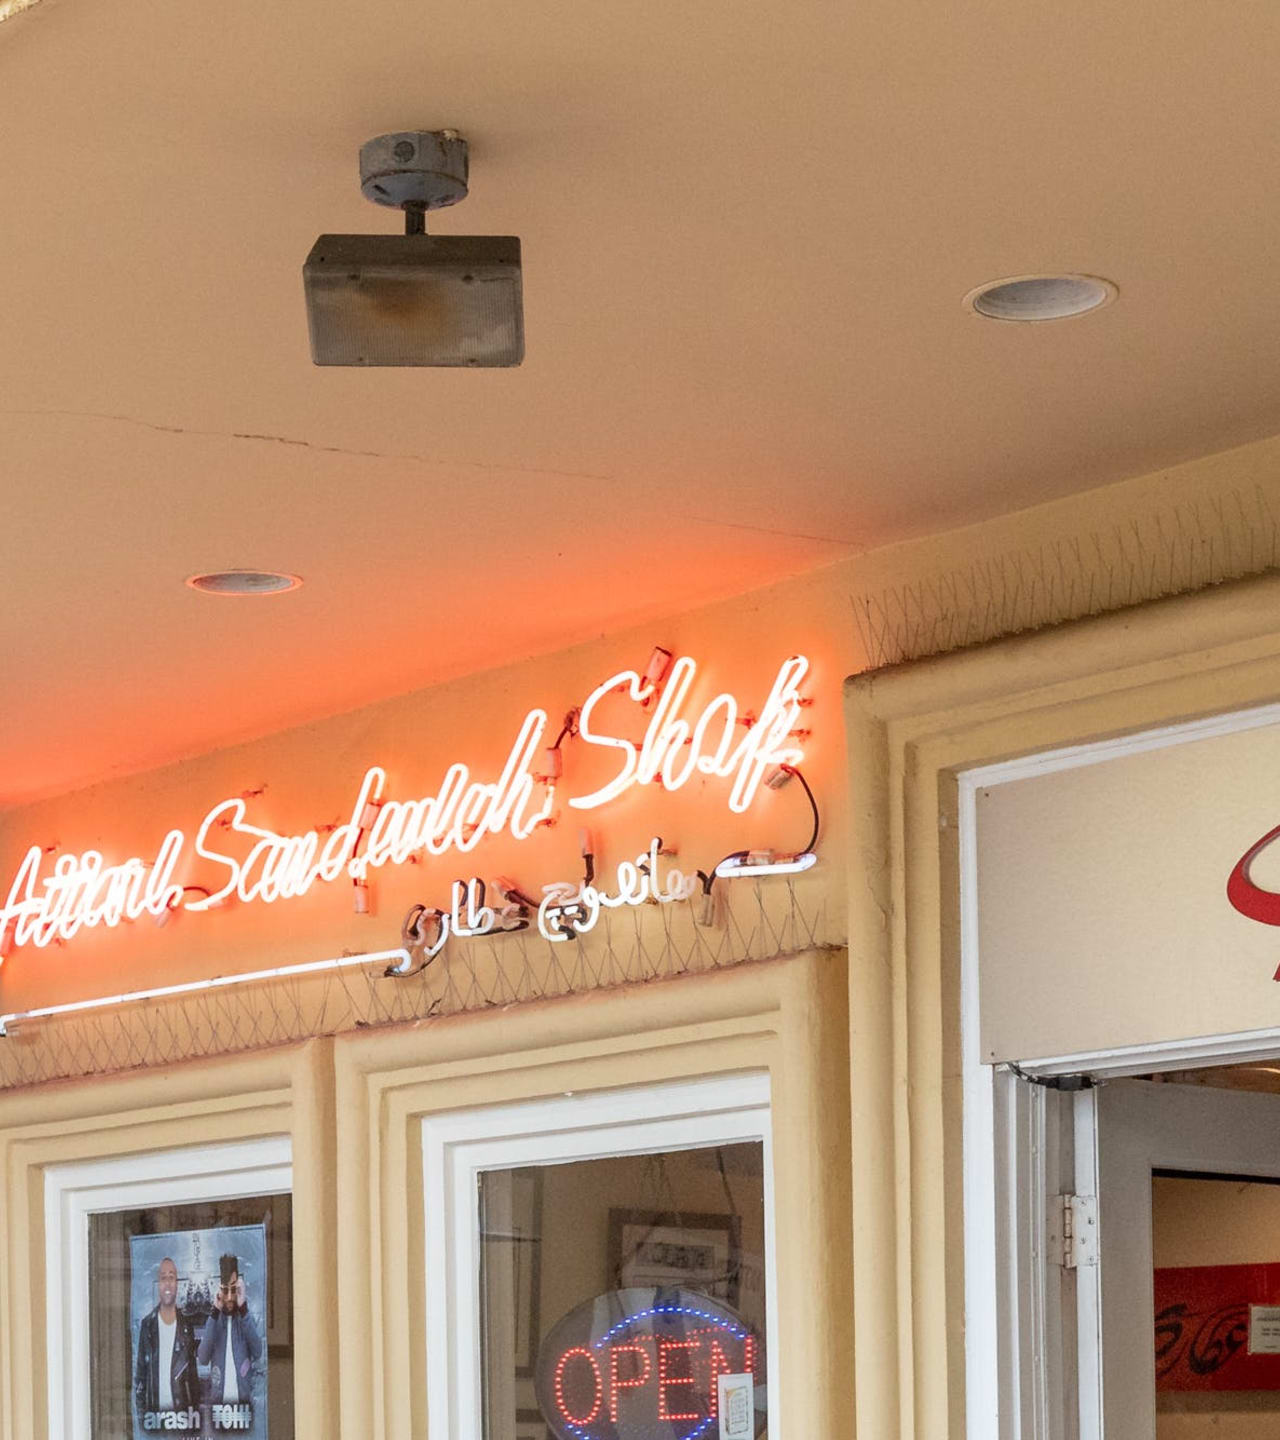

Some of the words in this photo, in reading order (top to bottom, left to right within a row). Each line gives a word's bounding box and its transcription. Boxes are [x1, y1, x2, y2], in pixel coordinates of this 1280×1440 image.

[570, 655, 810, 812] Shop
[143, 1405, 200, 1430] arash
[554, 1334, 757, 1426] OPEN
